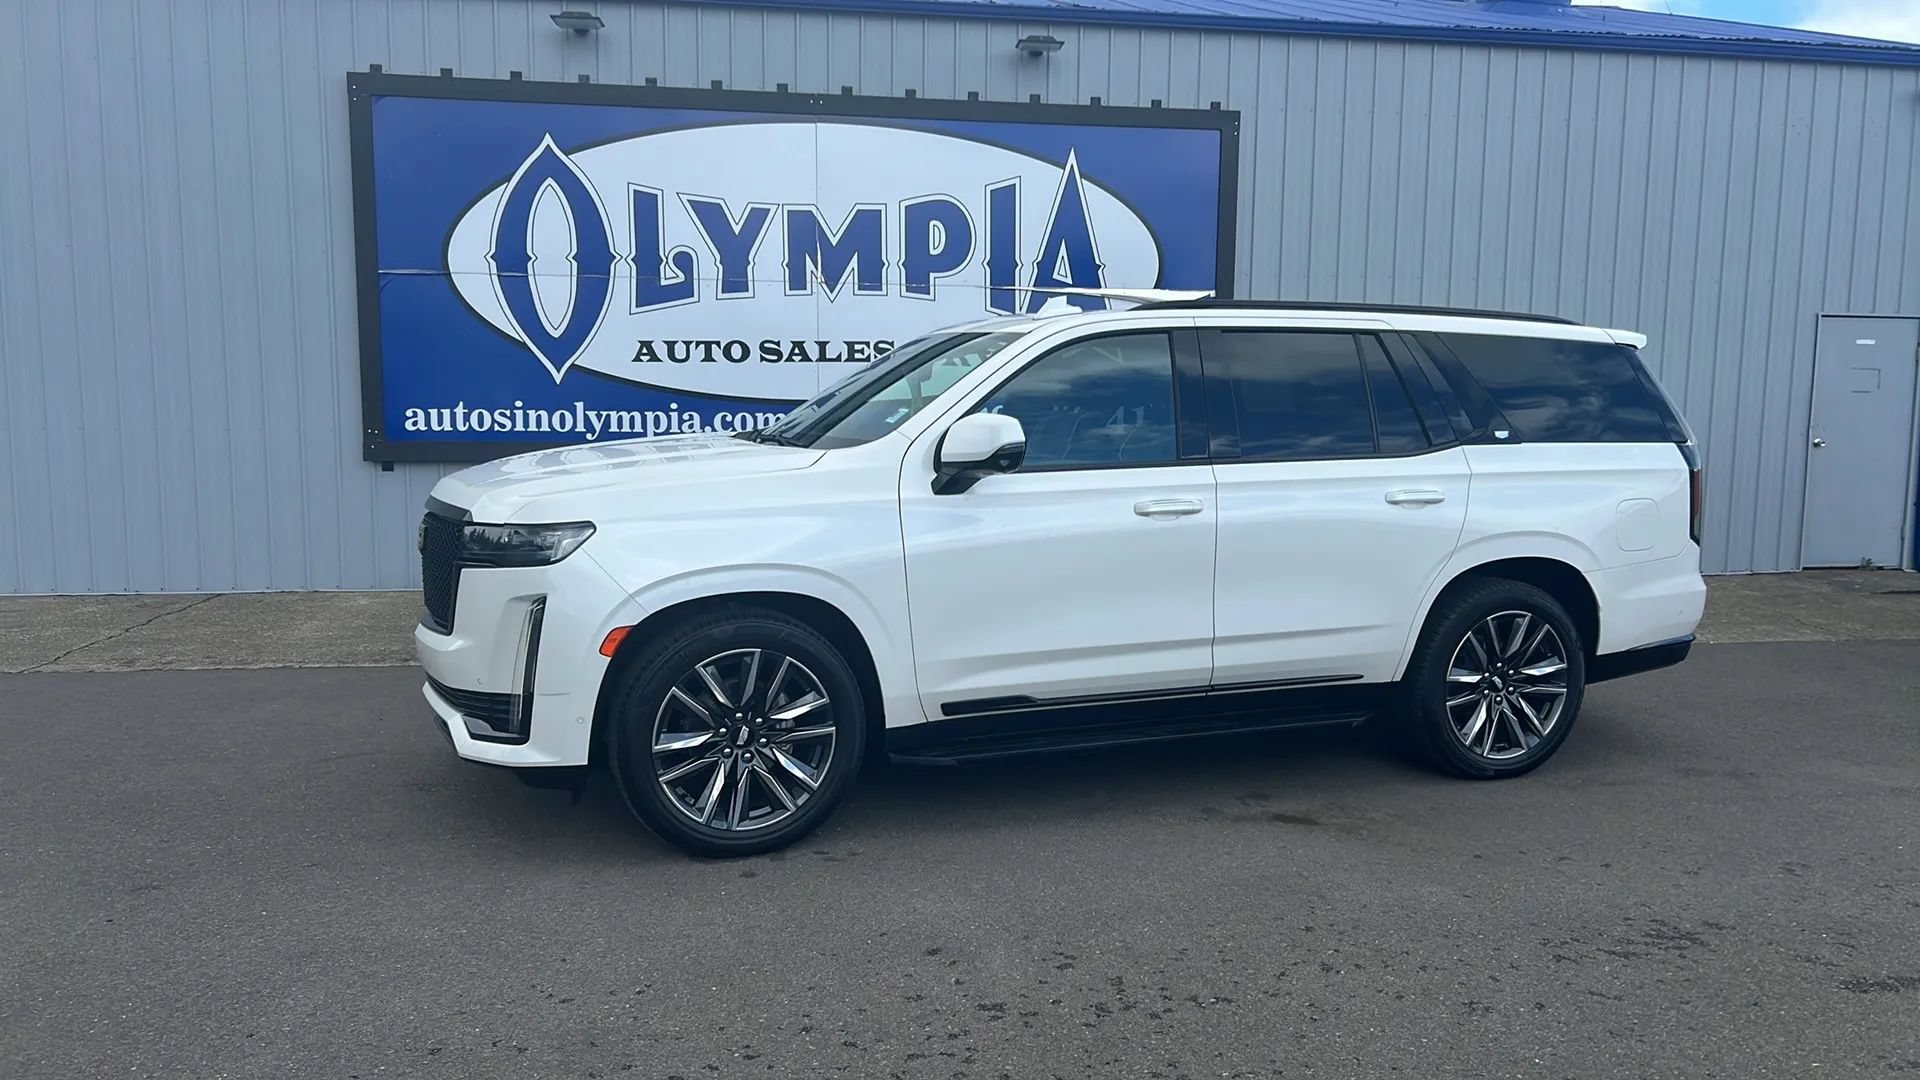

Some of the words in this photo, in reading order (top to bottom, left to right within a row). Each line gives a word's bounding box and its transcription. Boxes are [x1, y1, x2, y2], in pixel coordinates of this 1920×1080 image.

[485, 132, 1117, 384] OLYMPIA
[631, 339, 751, 364] AUTO
[759, 339, 895, 364] SALES
